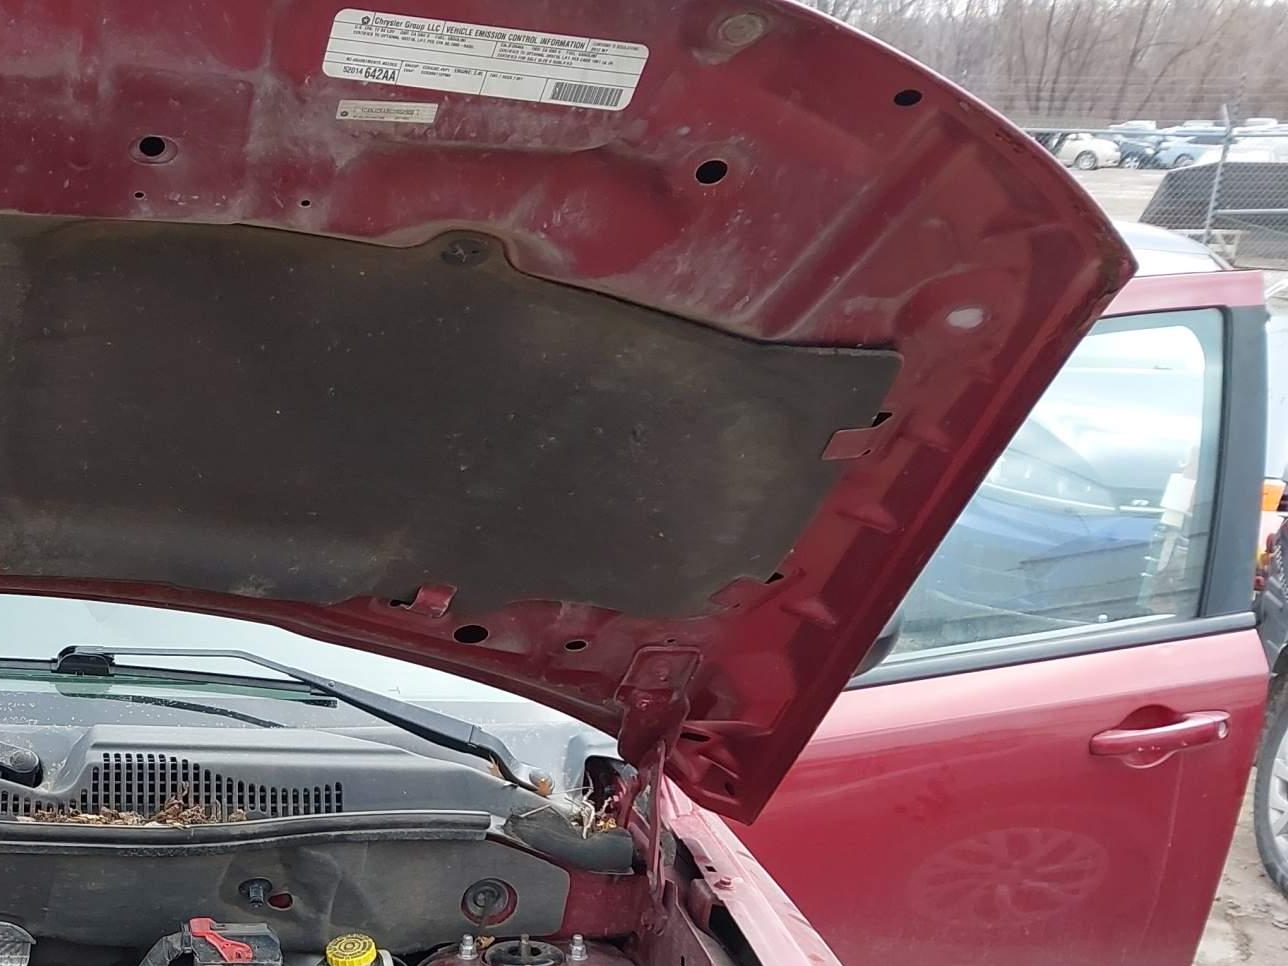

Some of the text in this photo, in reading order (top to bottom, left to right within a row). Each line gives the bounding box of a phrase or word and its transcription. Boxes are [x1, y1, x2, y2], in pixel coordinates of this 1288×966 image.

[374, 16, 403, 28] Chrysler
[404, 20, 426, 32] Group
[427, 23, 442, 33] LLC
[446, 26, 473, 37] VEHICLE
[474, 29, 507, 41] EMISSION
[508, 33, 538, 44] CONTROL
[539, 37, 586, 50] INFORMATION
[364, 67, 396, 82] 642AA
